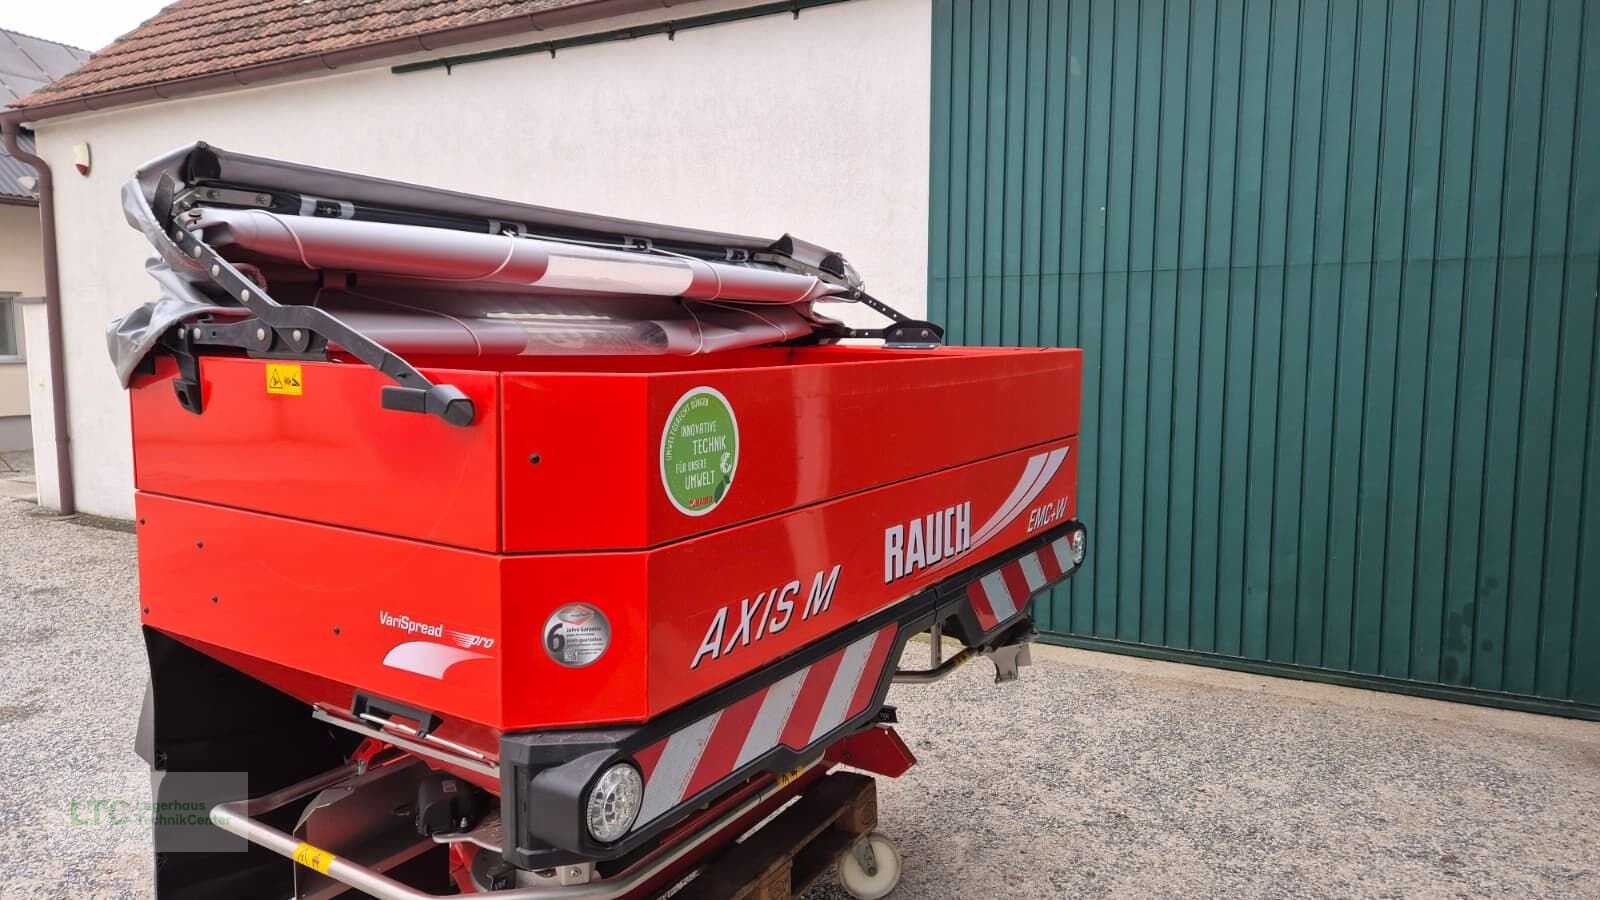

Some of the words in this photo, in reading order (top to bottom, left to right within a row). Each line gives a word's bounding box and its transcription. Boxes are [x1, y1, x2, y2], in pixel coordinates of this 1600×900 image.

[681, 420, 717, 438] INNOVATIVE
[693, 435, 726, 455] TECHNIK
[675, 460, 687, 474] FÜR
[684, 470, 716, 490] UMWELT
[1027, 496, 1068, 532] EMC+W
[884, 501, 971, 584] RAUCH
[379, 609, 443, 638] VariSpread
[689, 580, 801, 670] AXIS
[802, 564, 842, 620] M
[547, 622, 565, 653] 6
